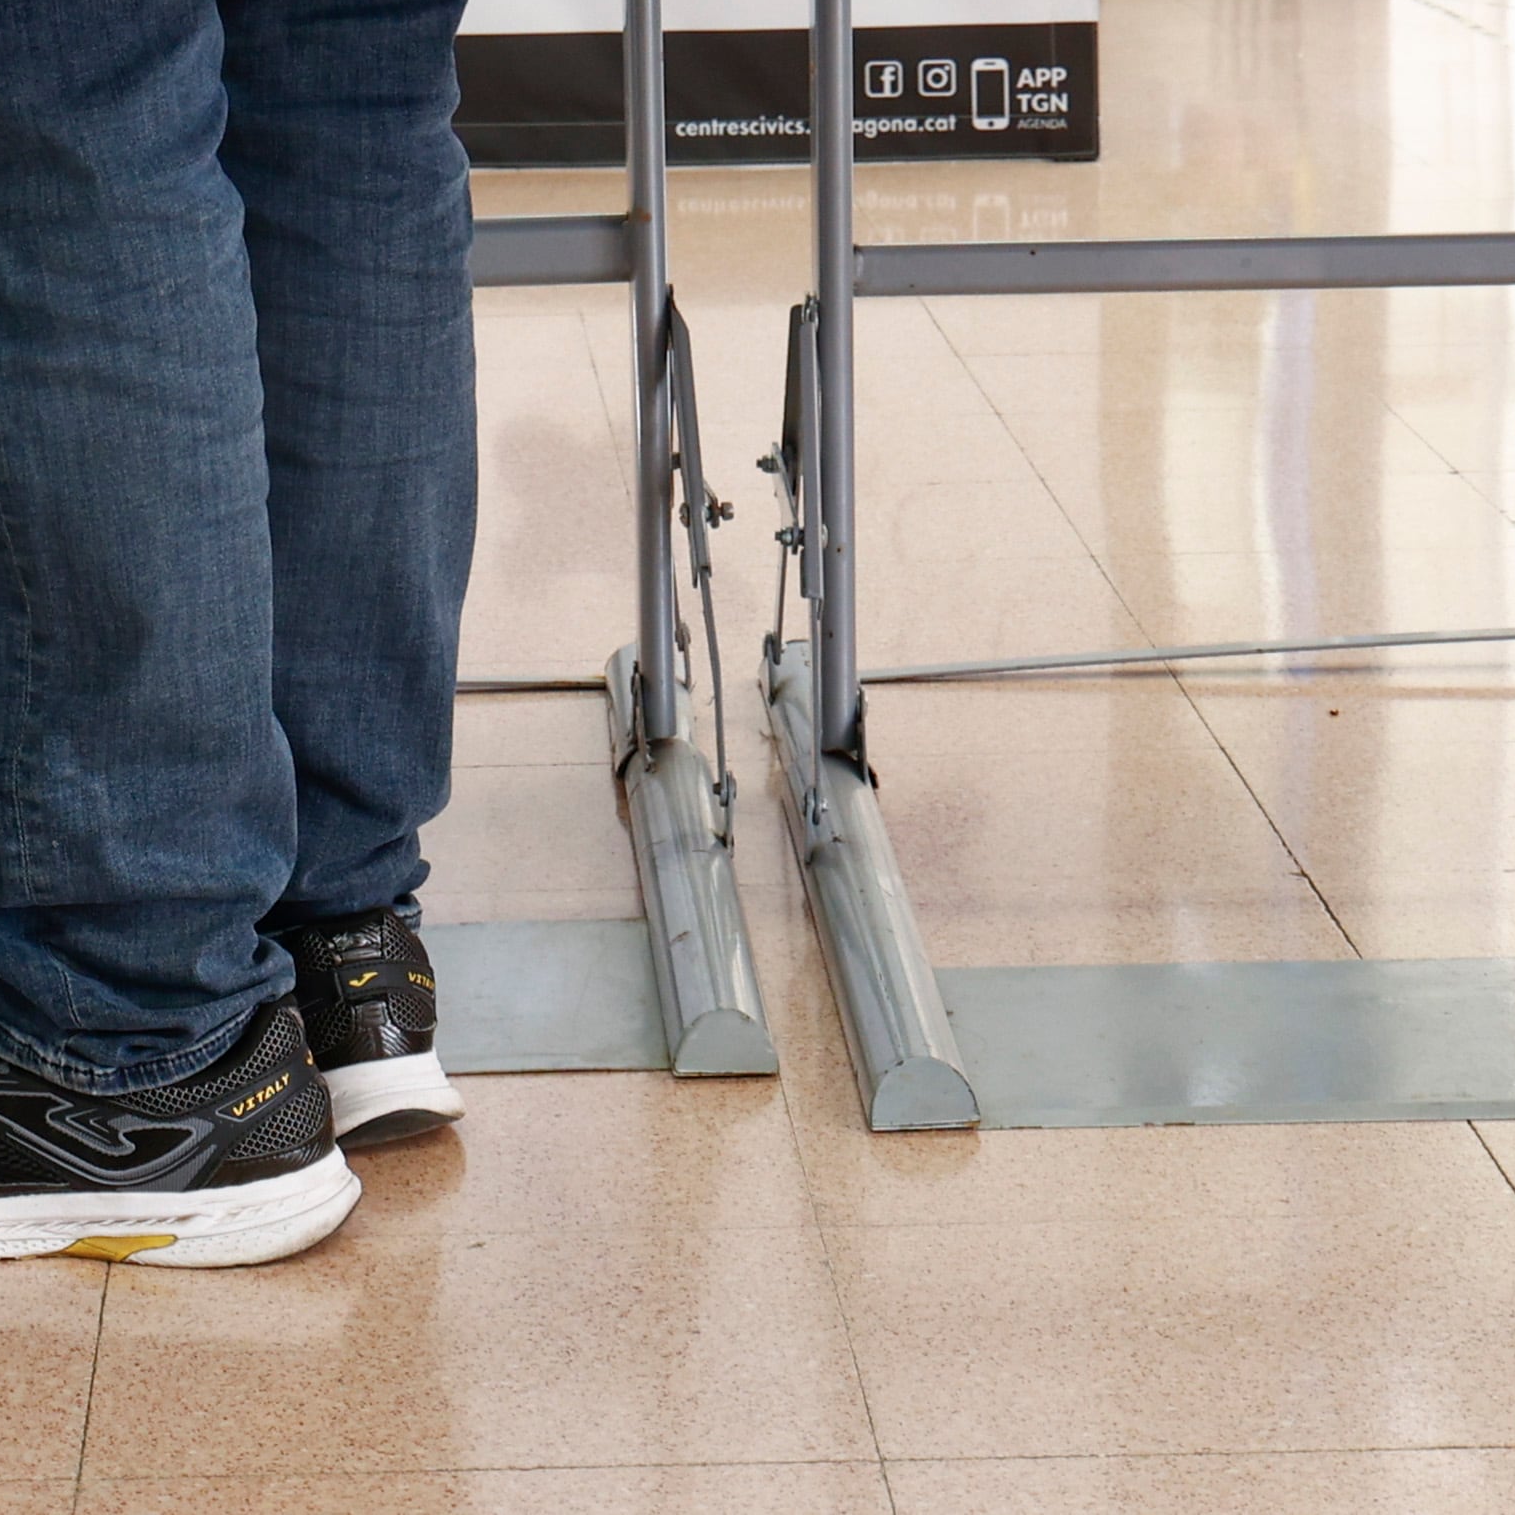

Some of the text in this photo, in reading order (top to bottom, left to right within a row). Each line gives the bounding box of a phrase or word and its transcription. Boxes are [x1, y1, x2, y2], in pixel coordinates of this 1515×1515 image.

[1016, 66, 1068, 89] APP
[1016, 92, 1069, 113] TGN
[675, 114, 957, 138] centrescivics.agona.cat
[1017, 118, 1068, 130] AGENDA
[232, 1072, 290, 1117] VITALY
